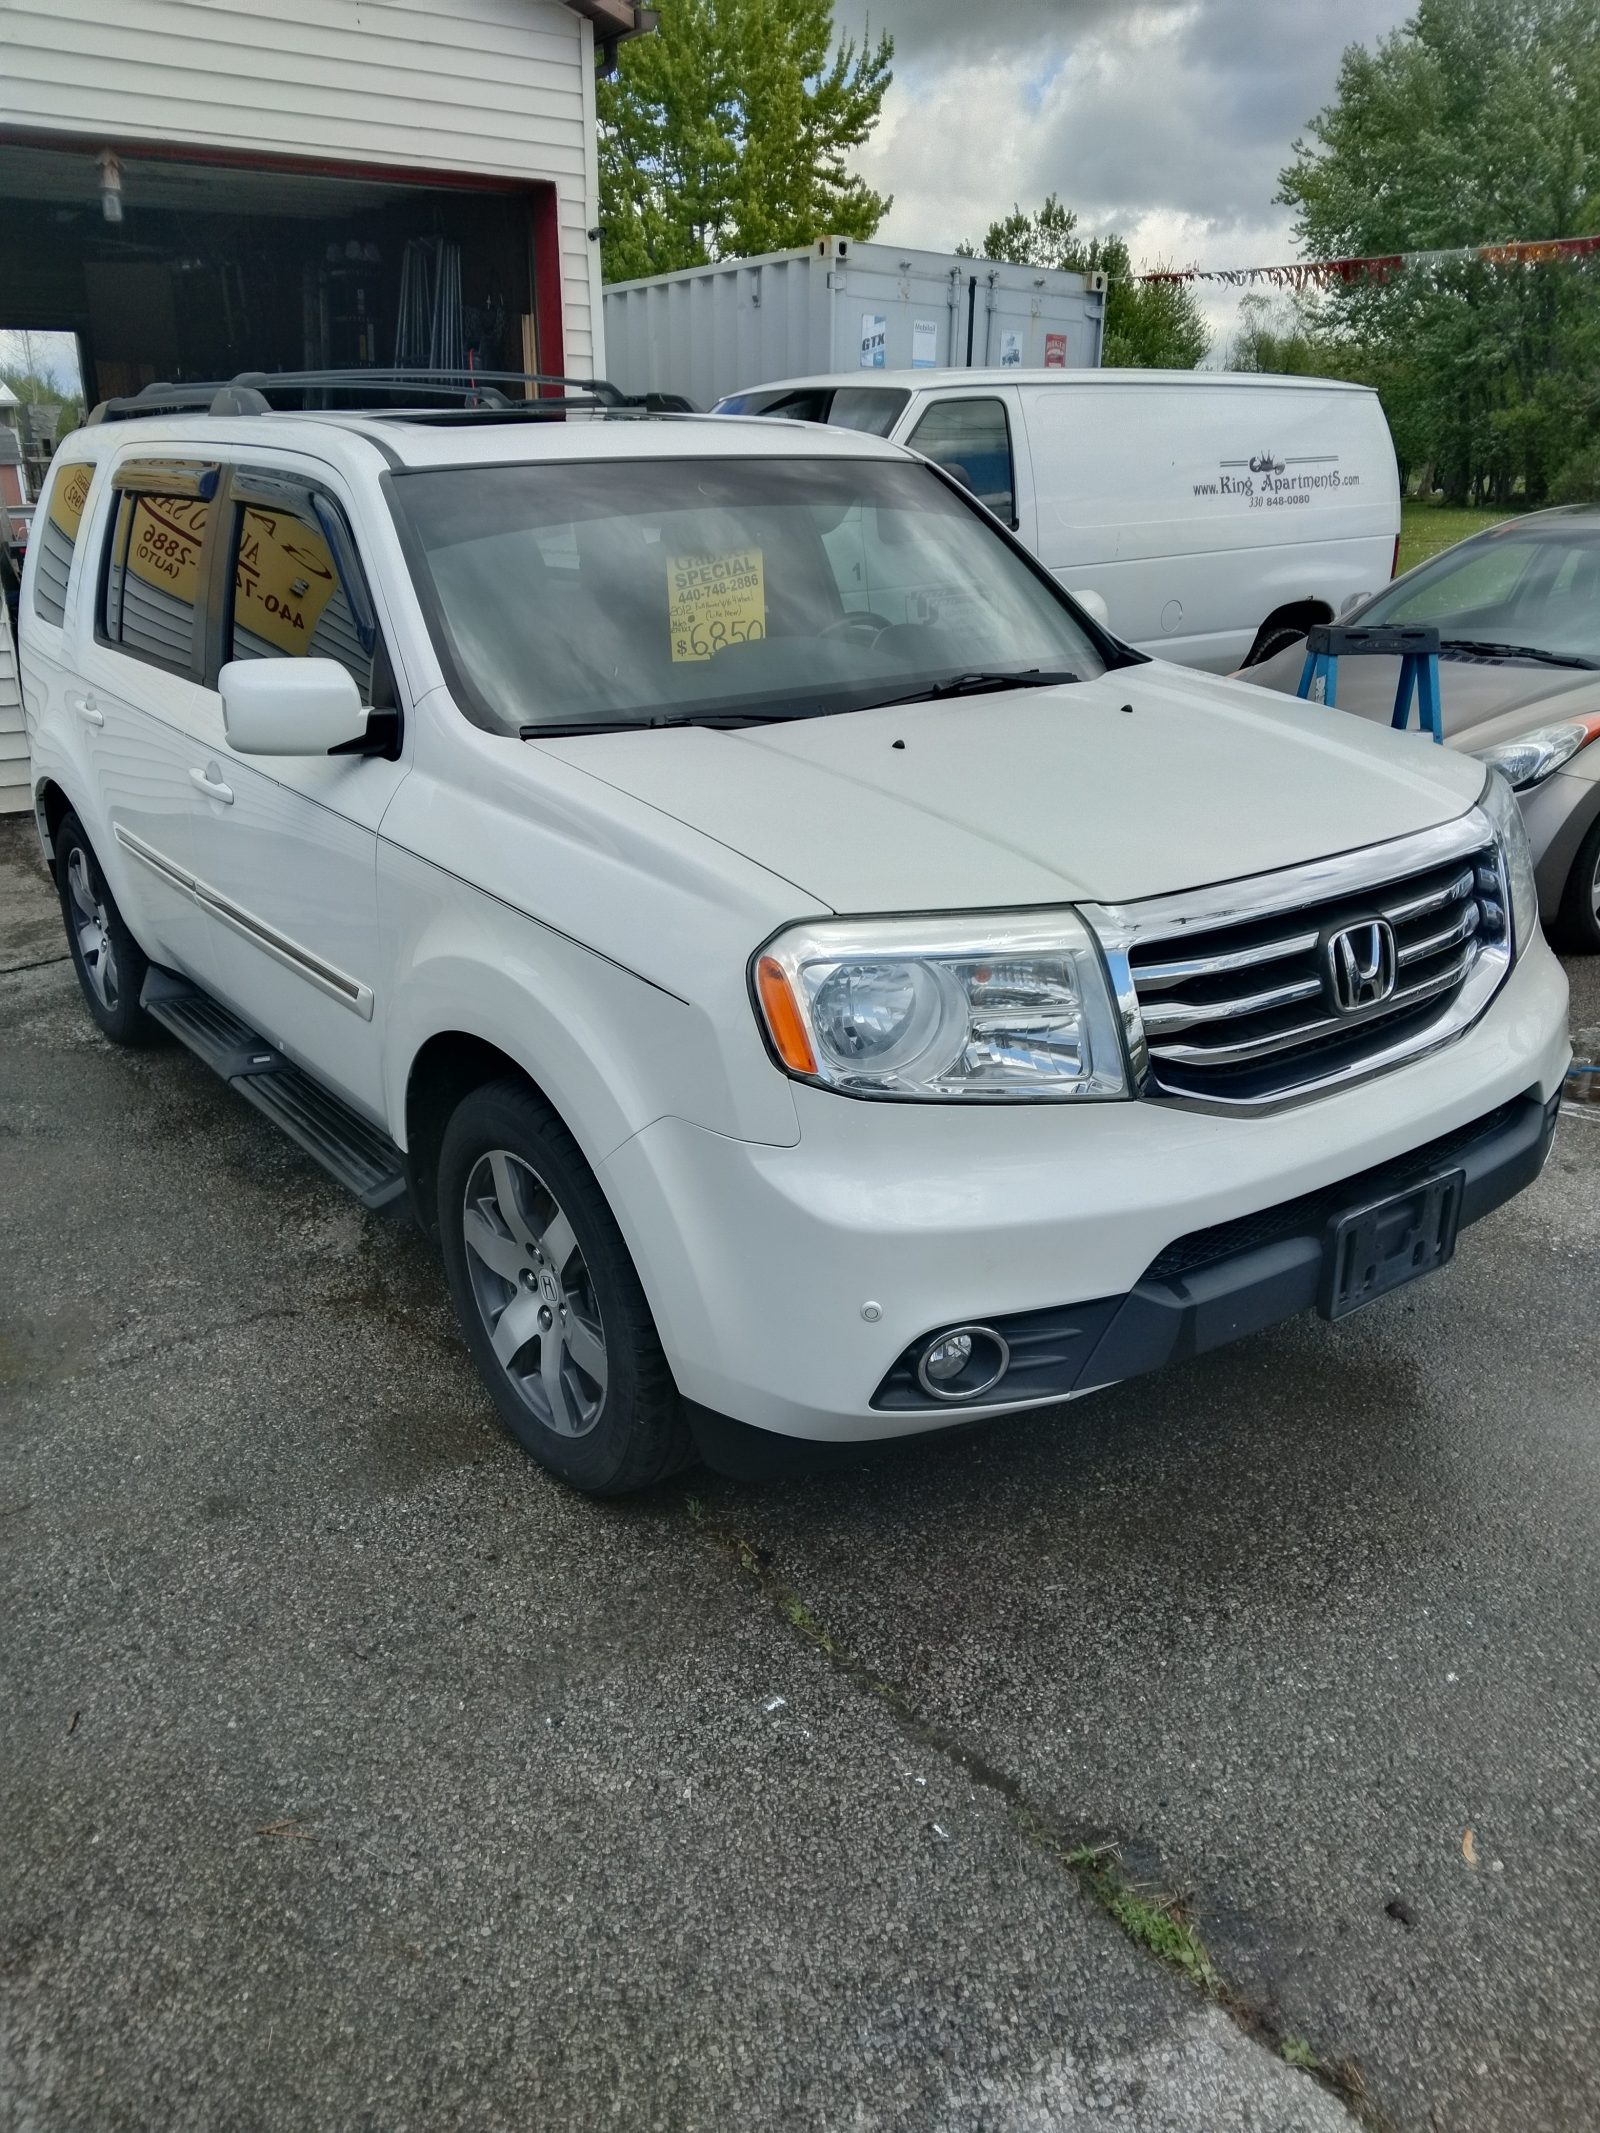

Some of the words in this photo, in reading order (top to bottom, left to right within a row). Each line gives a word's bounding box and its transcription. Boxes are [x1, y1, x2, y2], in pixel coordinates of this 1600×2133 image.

[862, 332, 885, 351] GTX
[1248, 497, 1264, 508] 330
[1266, 494, 1310, 507] 848-0080
[675, 557, 756, 588] SPECIAL
[678, 574, 759, 604] 440-748-2886
